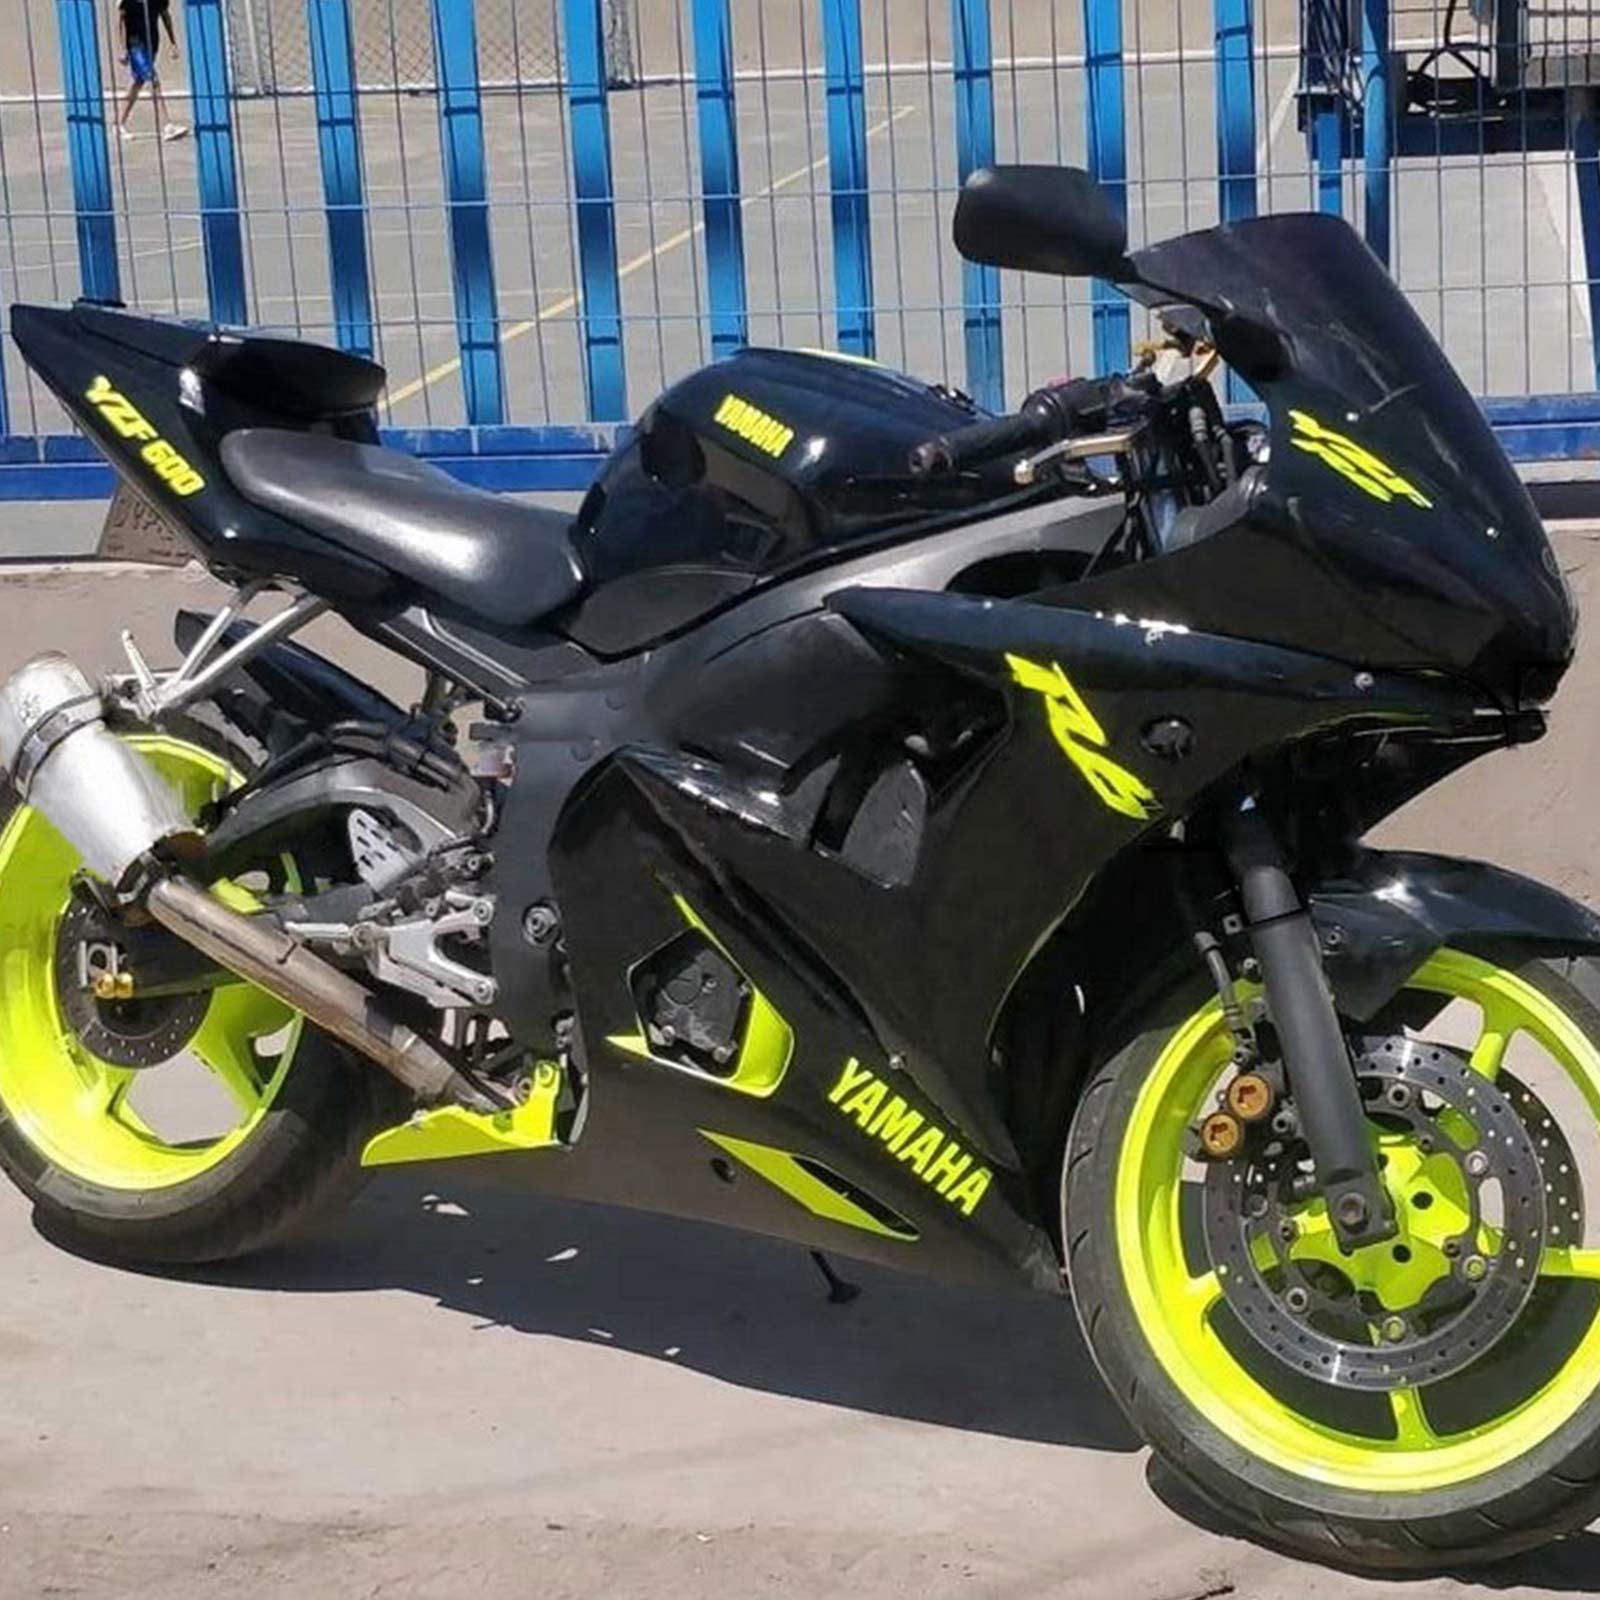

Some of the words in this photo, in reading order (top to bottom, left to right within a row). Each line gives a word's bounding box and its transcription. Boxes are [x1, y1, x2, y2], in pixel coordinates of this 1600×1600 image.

[86, 375, 159, 440] YZF
[141, 439, 206, 496] 600
[713, 393, 795, 459] YAMAHA
[827, 1055, 994, 1216] YAMAHA
